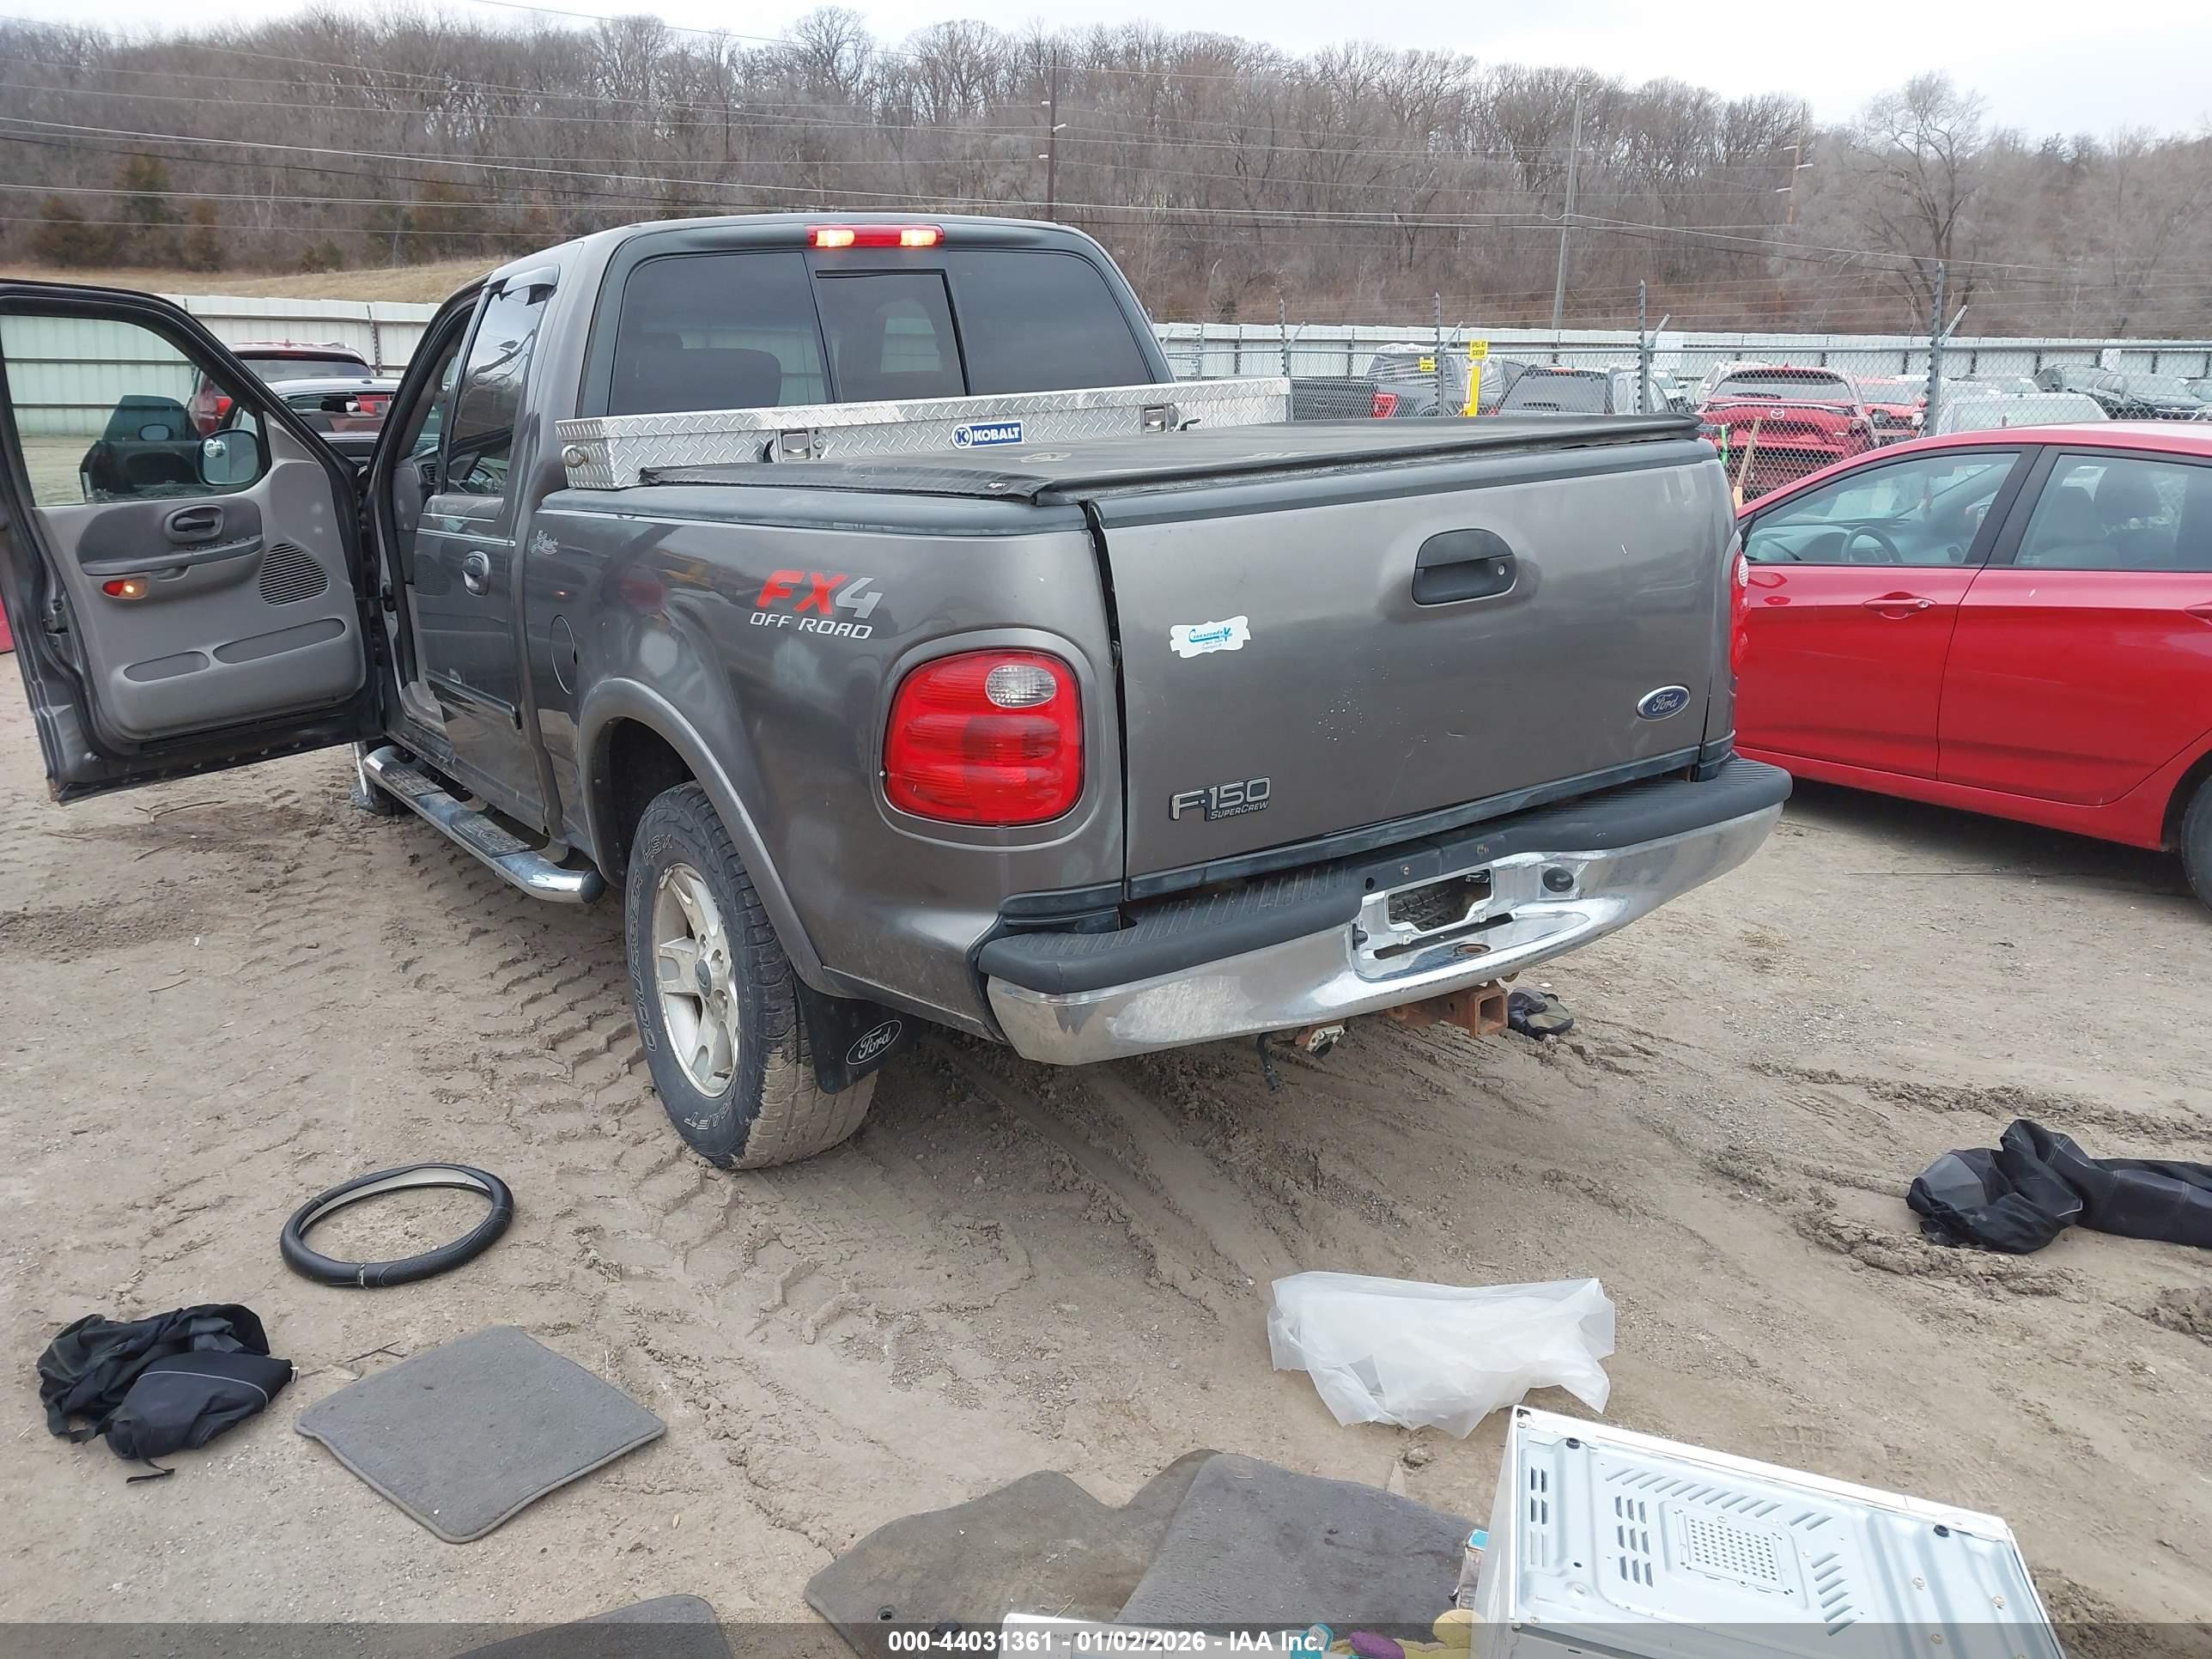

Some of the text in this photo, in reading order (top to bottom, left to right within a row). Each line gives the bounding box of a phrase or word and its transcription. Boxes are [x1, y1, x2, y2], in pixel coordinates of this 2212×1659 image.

[973, 428, 1019, 441] KOBALT
[756, 570, 883, 619] FX4
[750, 612, 873, 640] OFF ROAD
[1652, 693, 1680, 712] Ford
[859, 1026, 892, 1059] Ford
